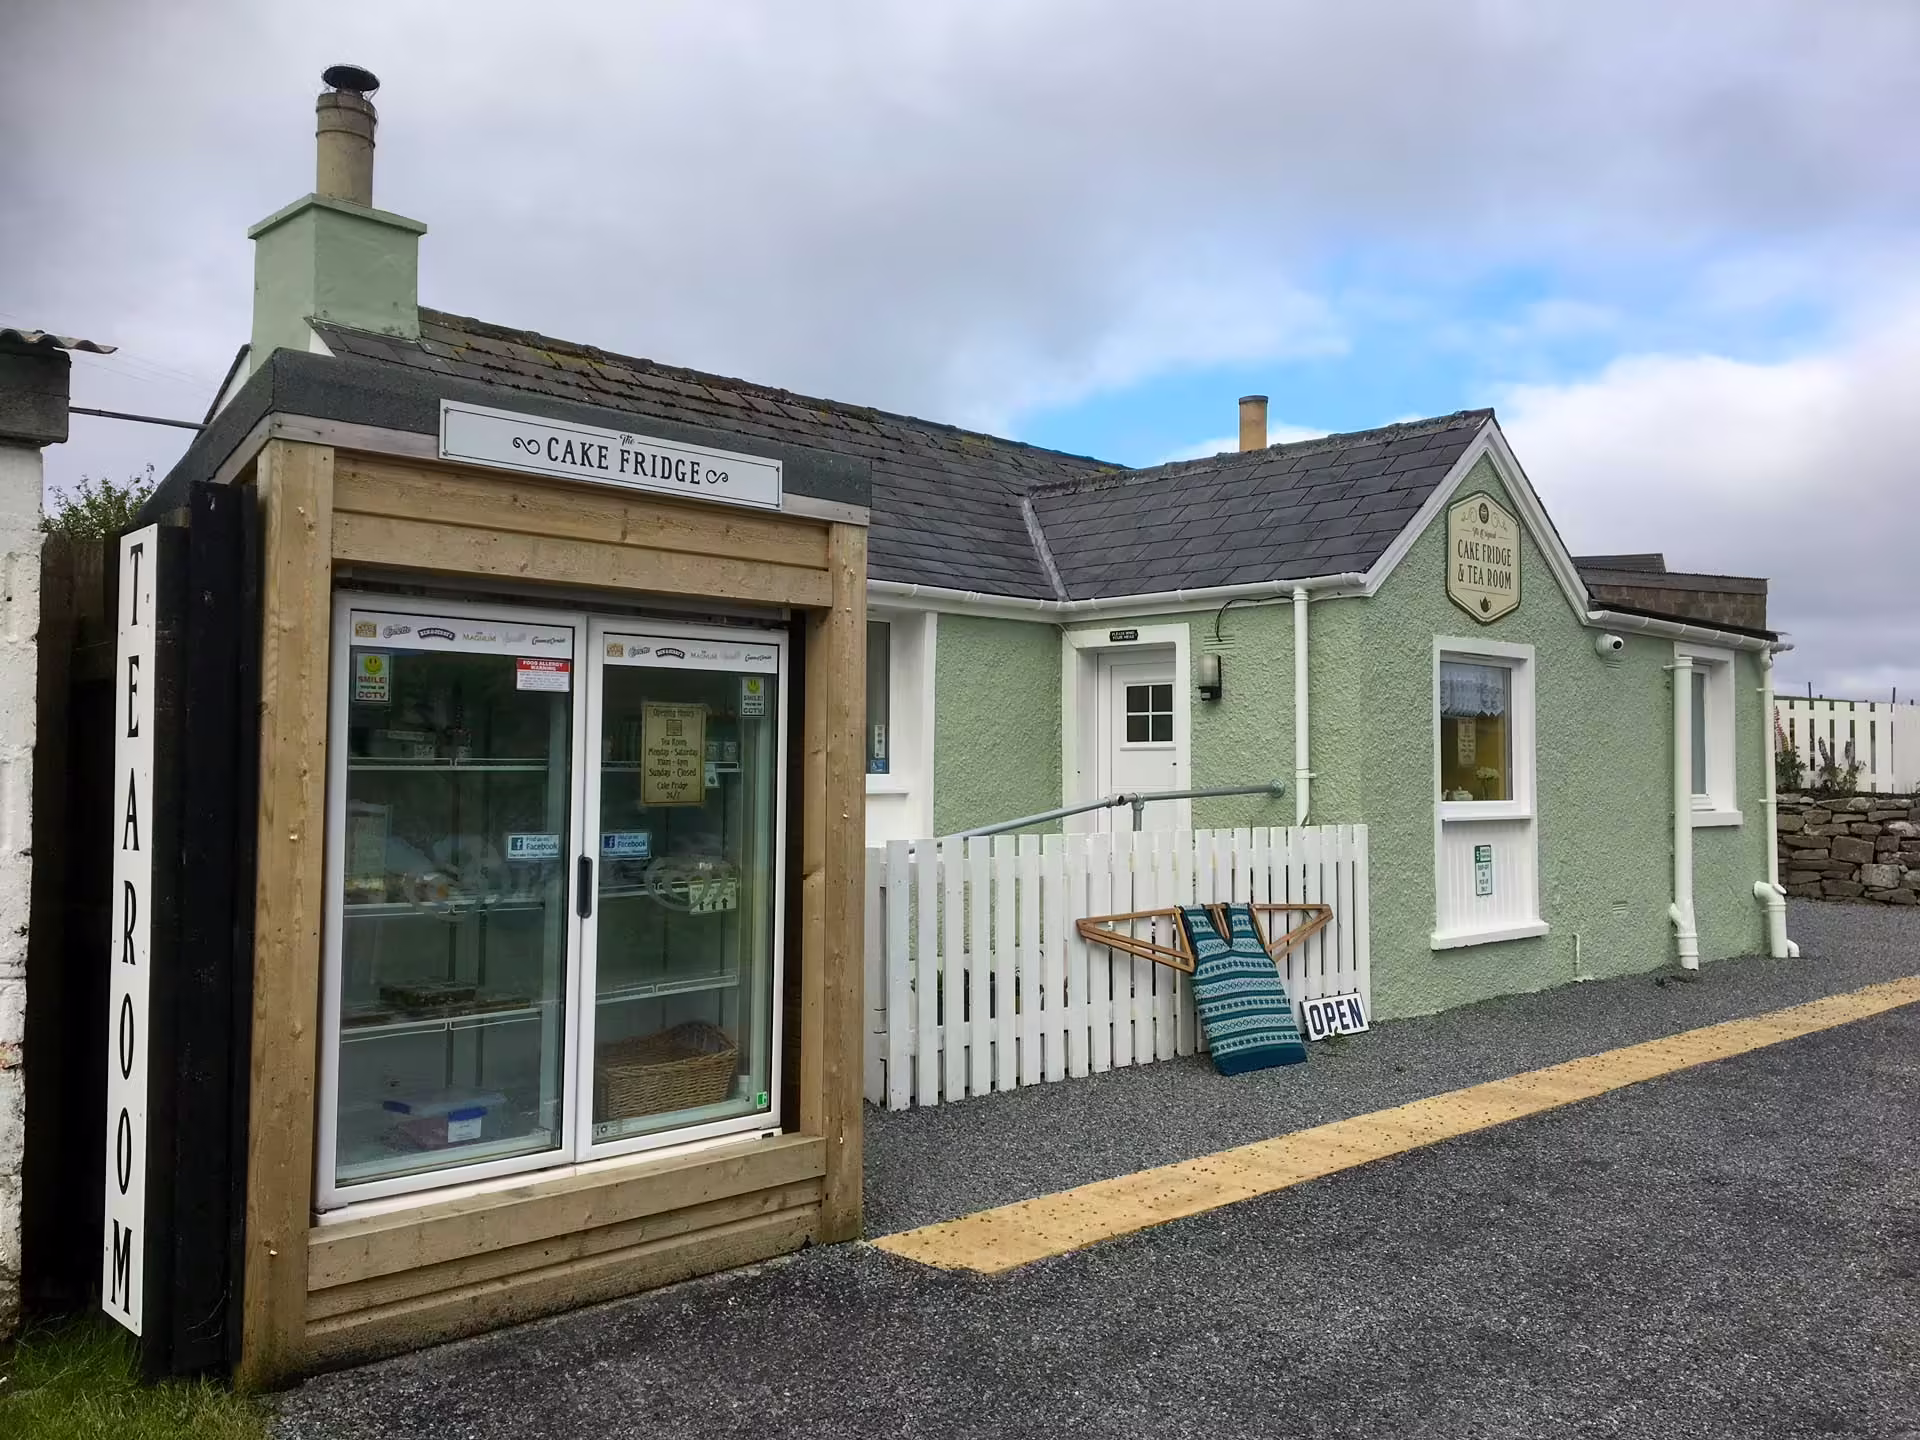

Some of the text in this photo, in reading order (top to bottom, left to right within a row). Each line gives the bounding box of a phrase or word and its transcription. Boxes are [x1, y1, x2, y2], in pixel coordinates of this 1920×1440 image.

[619, 433, 636, 446] The
[546, 436, 701, 485] CAKE FRIDGE
[1457, 539, 1512, 567] CAKE FRIDGE
[1457, 563, 1512, 590] & TEA ROOM
[357, 691, 386, 699] CCTV
[648, 748, 670, 757] Monday
[674, 748, 698, 757] Saturday
[648, 768, 671, 778] Sunday
[677, 768, 697, 777] Closed
[656, 781, 688, 791] Cake Fridge
[526, 842, 559, 850] Facebook
[617, 840, 647, 848] Facebook
[110, 542, 145, 1316] TEA ROOM
[1308, 997, 1364, 1036] OPEN
